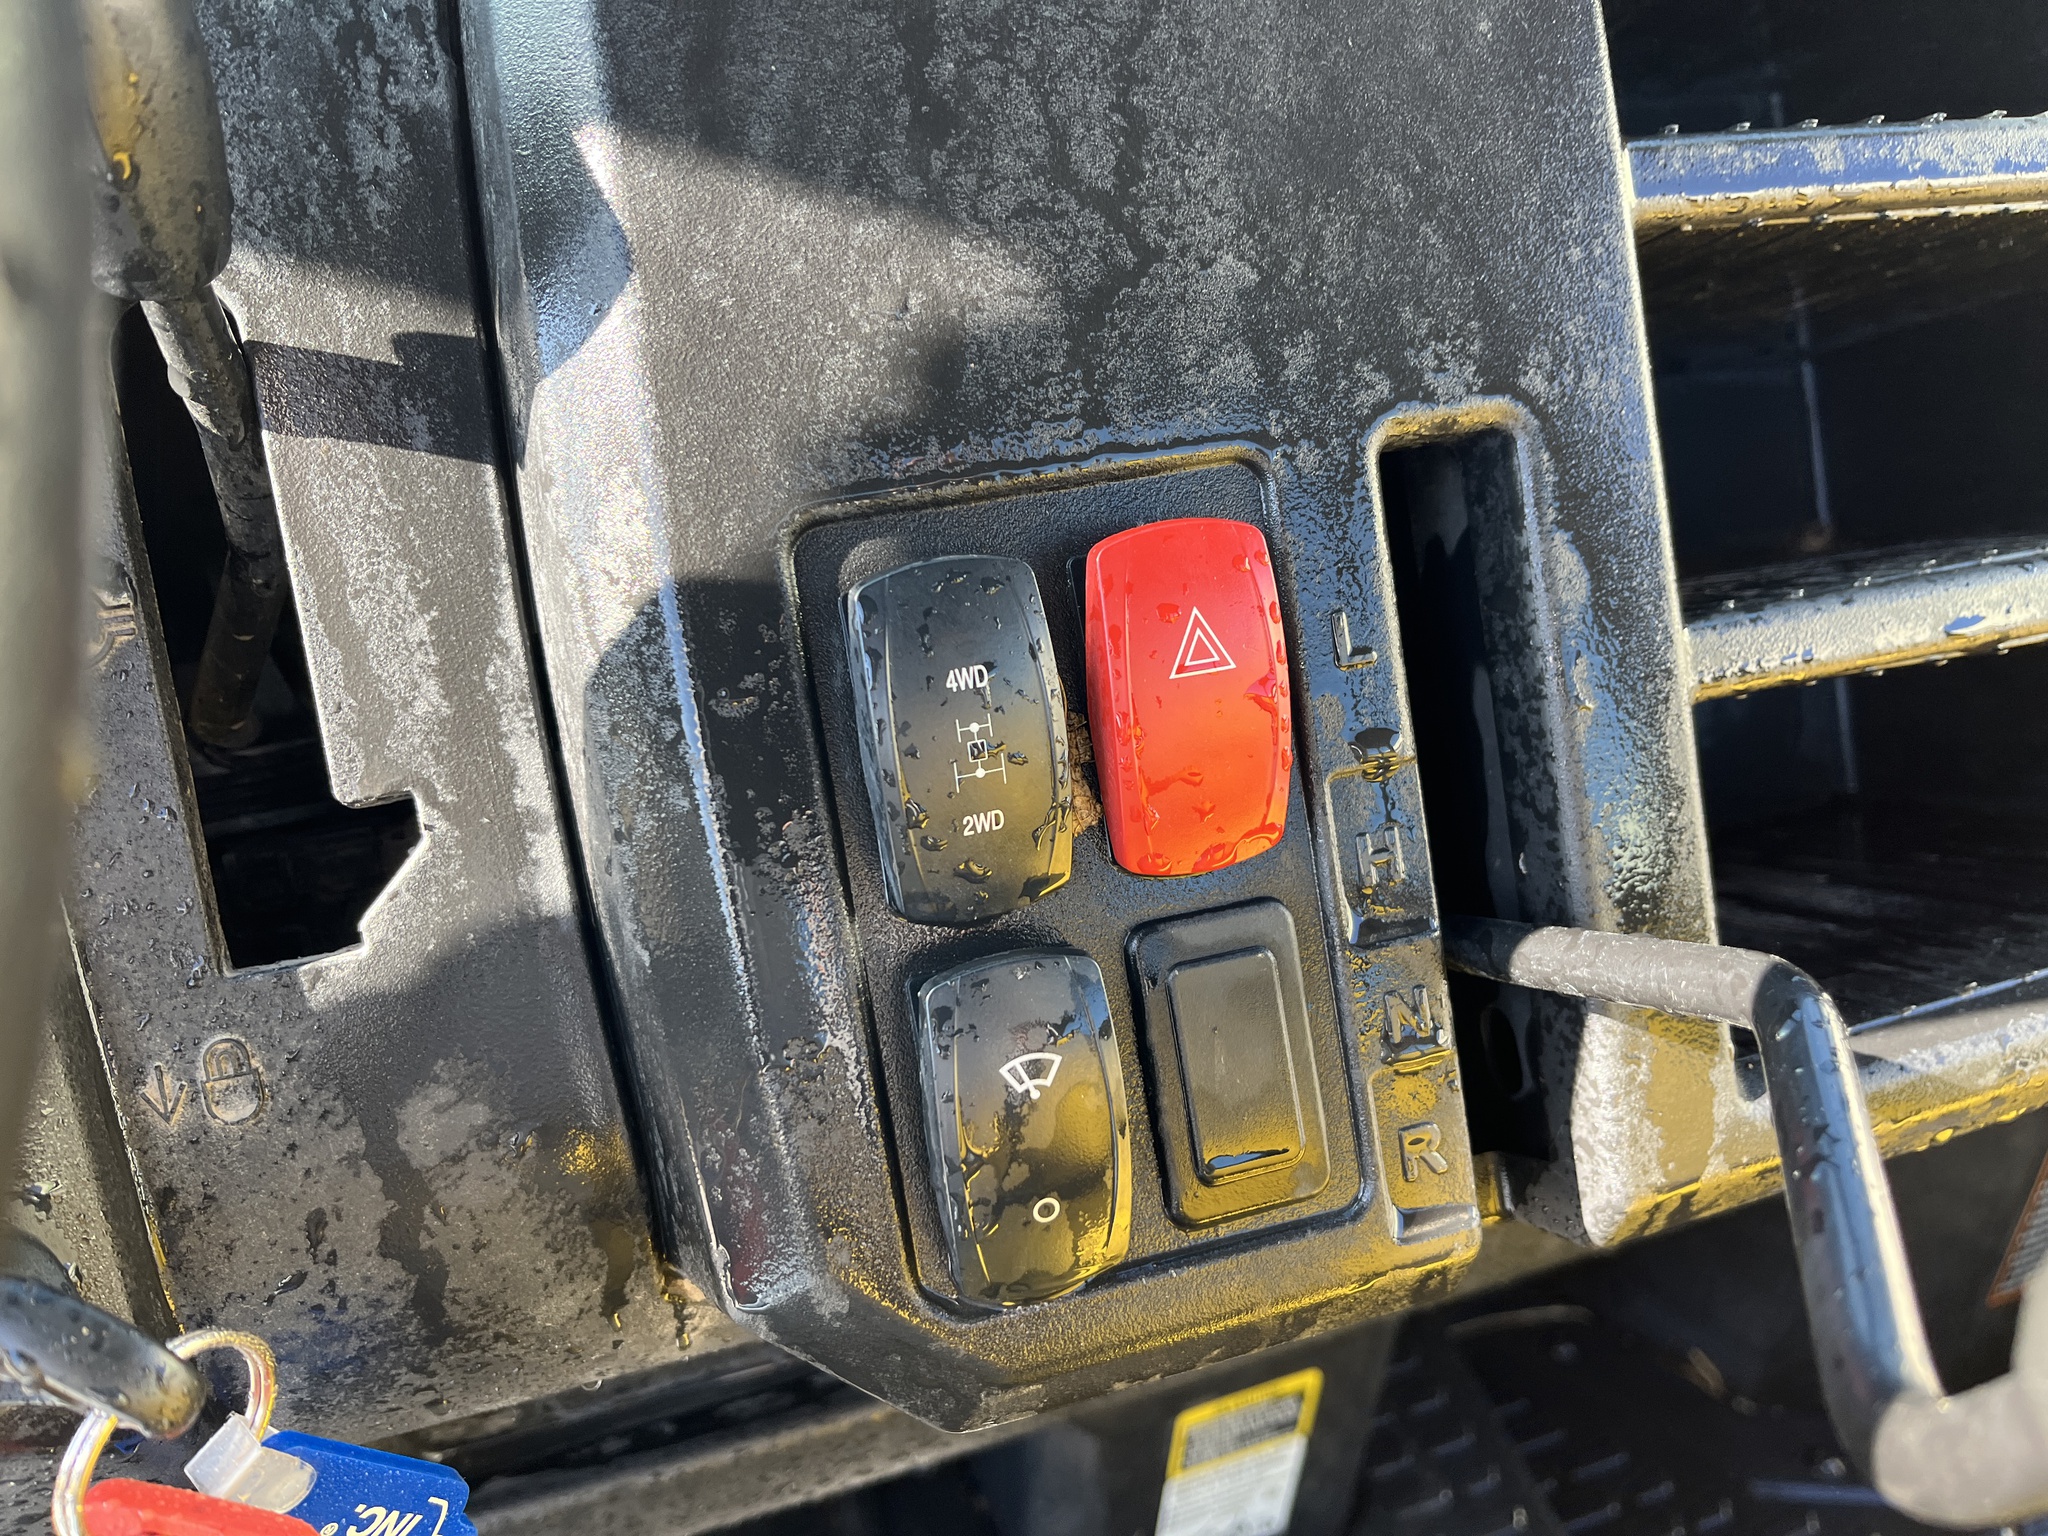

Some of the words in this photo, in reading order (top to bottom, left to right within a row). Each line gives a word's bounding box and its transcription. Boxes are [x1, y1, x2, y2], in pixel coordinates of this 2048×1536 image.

[1331, 611, 1378, 672] L
[945, 664, 989, 693] 4WD
[962, 809, 1005, 837] 2WD
[1355, 826, 1405, 893] H
[1383, 984, 1435, 1046] N
[1398, 1121, 1449, 1182] R
